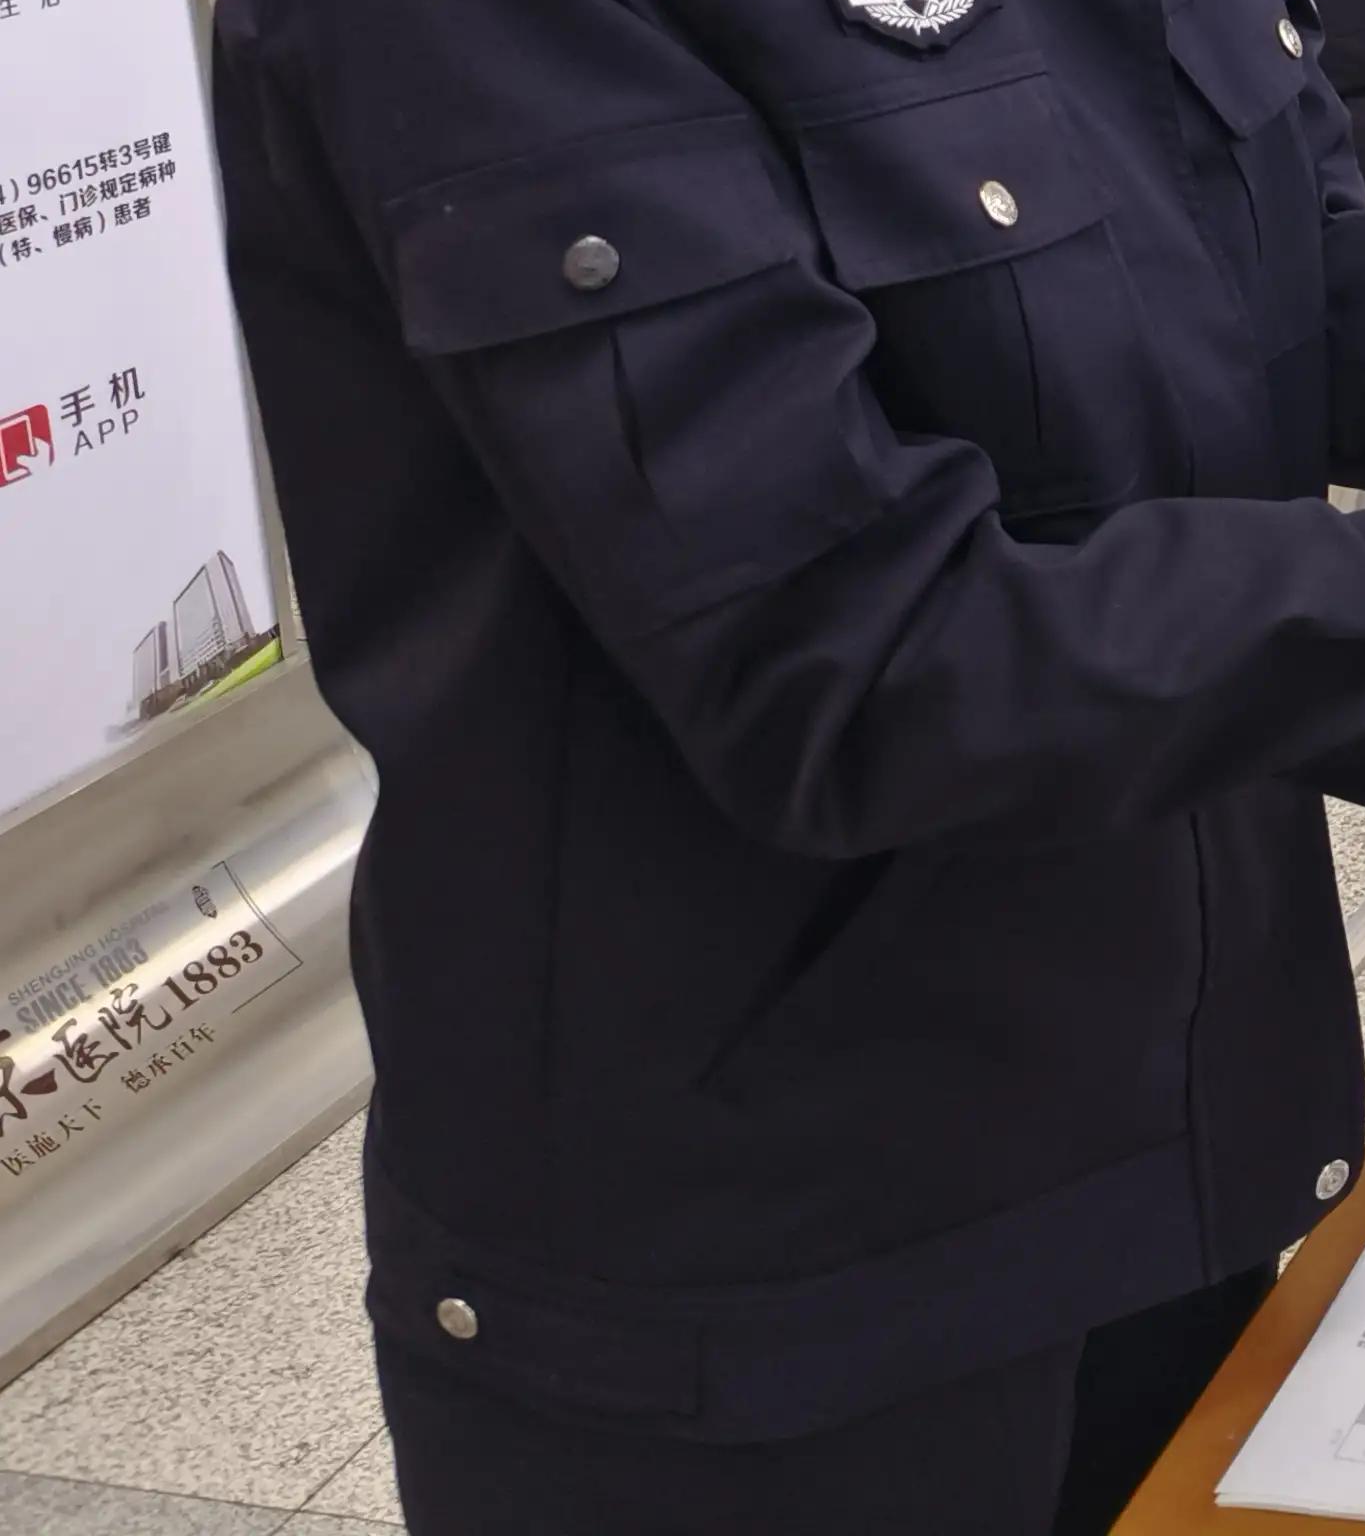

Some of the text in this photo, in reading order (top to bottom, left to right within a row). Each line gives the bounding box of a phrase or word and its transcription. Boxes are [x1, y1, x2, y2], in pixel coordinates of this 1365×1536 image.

[0, 159, 177, 236] 医保、门诊规定病种
[60, 368, 146, 428] 手机
[74, 408, 139, 456] APP
[163, 930, 264, 1011] 1883
[15, 974, 93, 1034] SINCE
